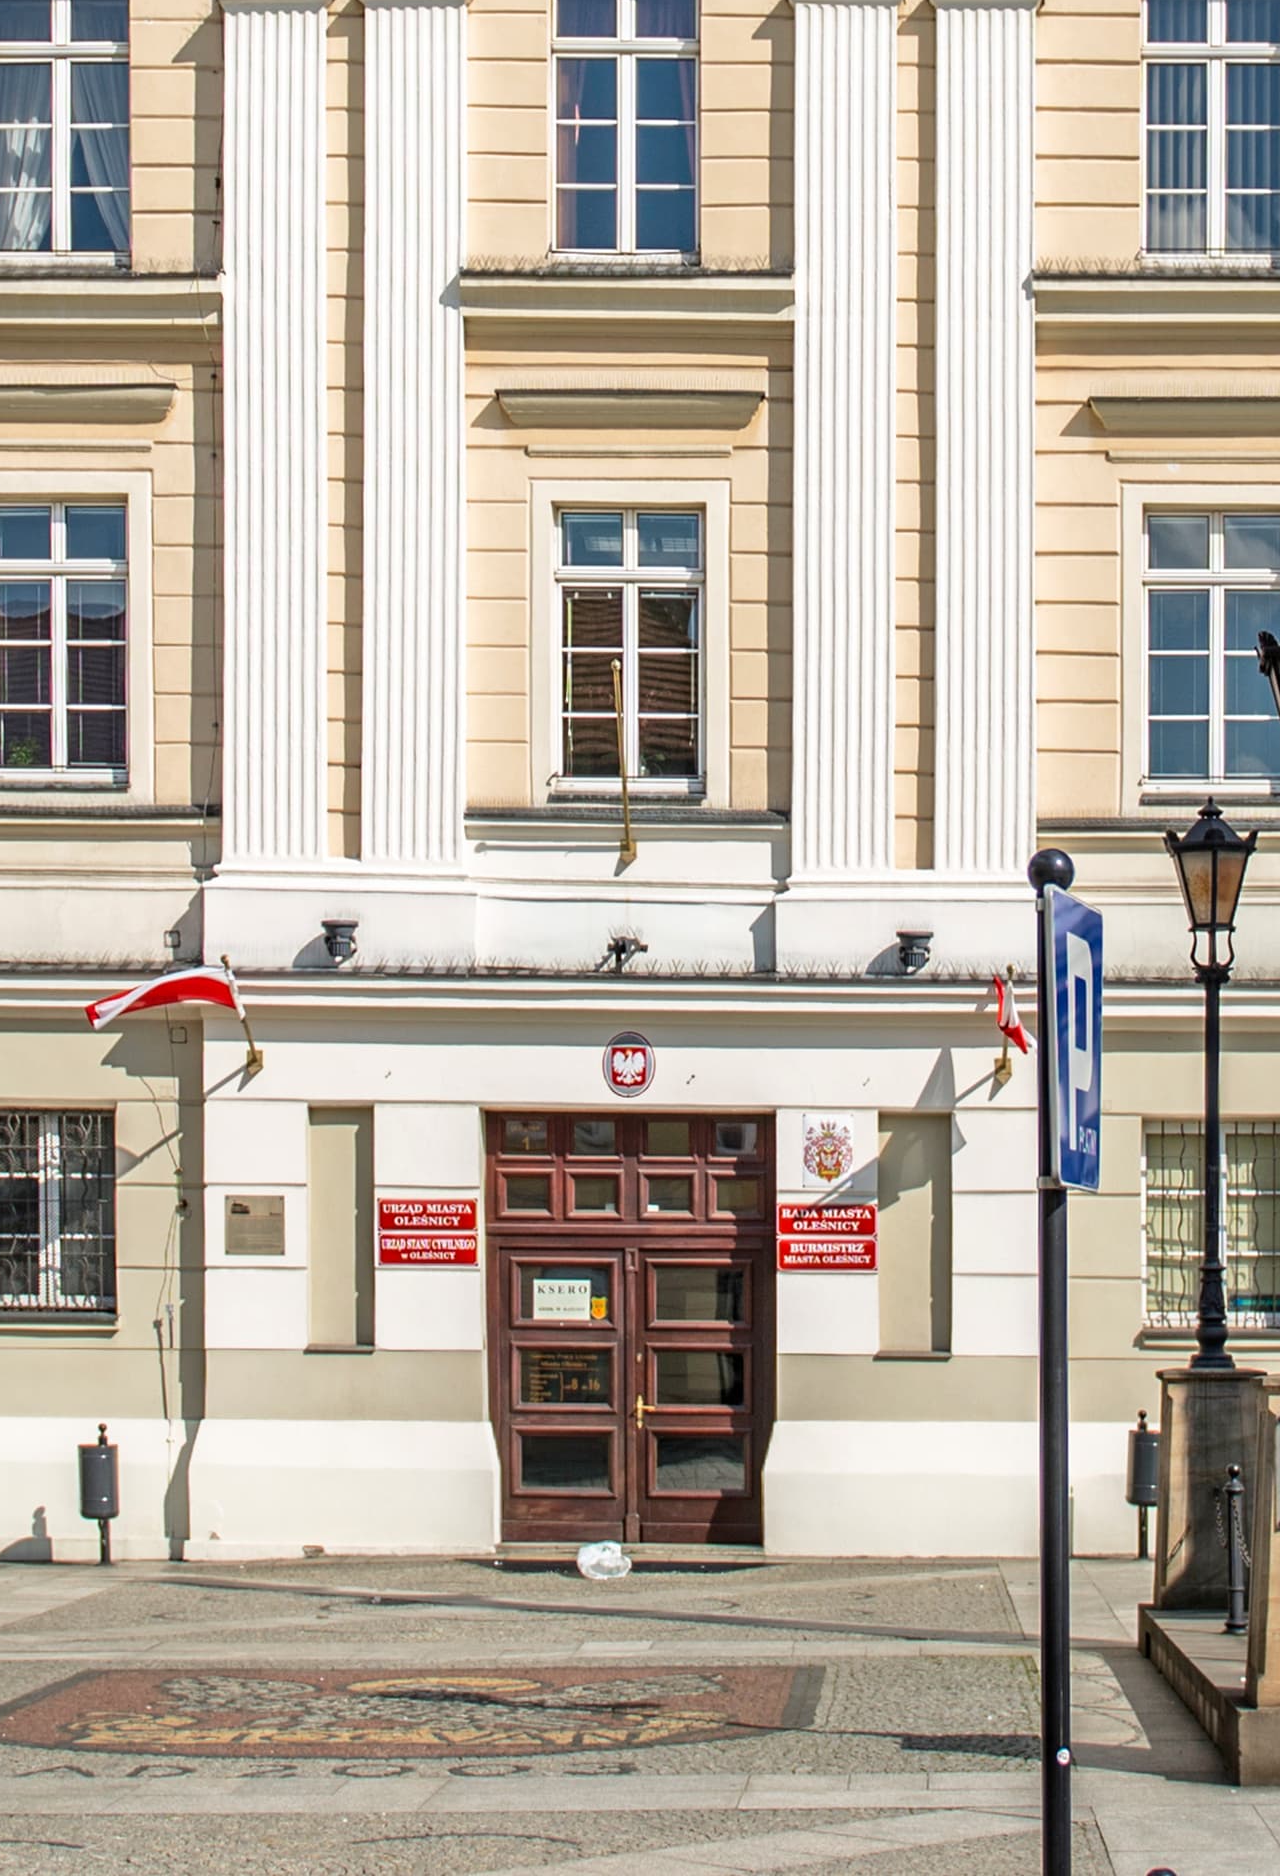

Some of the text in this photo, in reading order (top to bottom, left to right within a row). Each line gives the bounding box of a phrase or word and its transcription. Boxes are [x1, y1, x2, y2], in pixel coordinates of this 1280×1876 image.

[1066, 931, 1093, 1152] P
[383, 1204, 472, 1215] URZĄD MIASTA
[781, 1209, 872, 1219] RADA MIASTA
[393, 1214, 460, 1226] OLEŚNICY
[792, 1219, 860, 1231] OLEŚNICY
[381, 1239, 476, 1251] URZĄD STANU CYWILNEGO
[790, 1243, 865, 1253] BURMISTRZ
[409, 1250, 456, 1260] OLEŚNICY
[783, 1253, 871, 1264] MIASTA OLEŚNICY
[537, 1284, 588, 1294] KSERO
[236, 1762, 638, 1779] 2003
